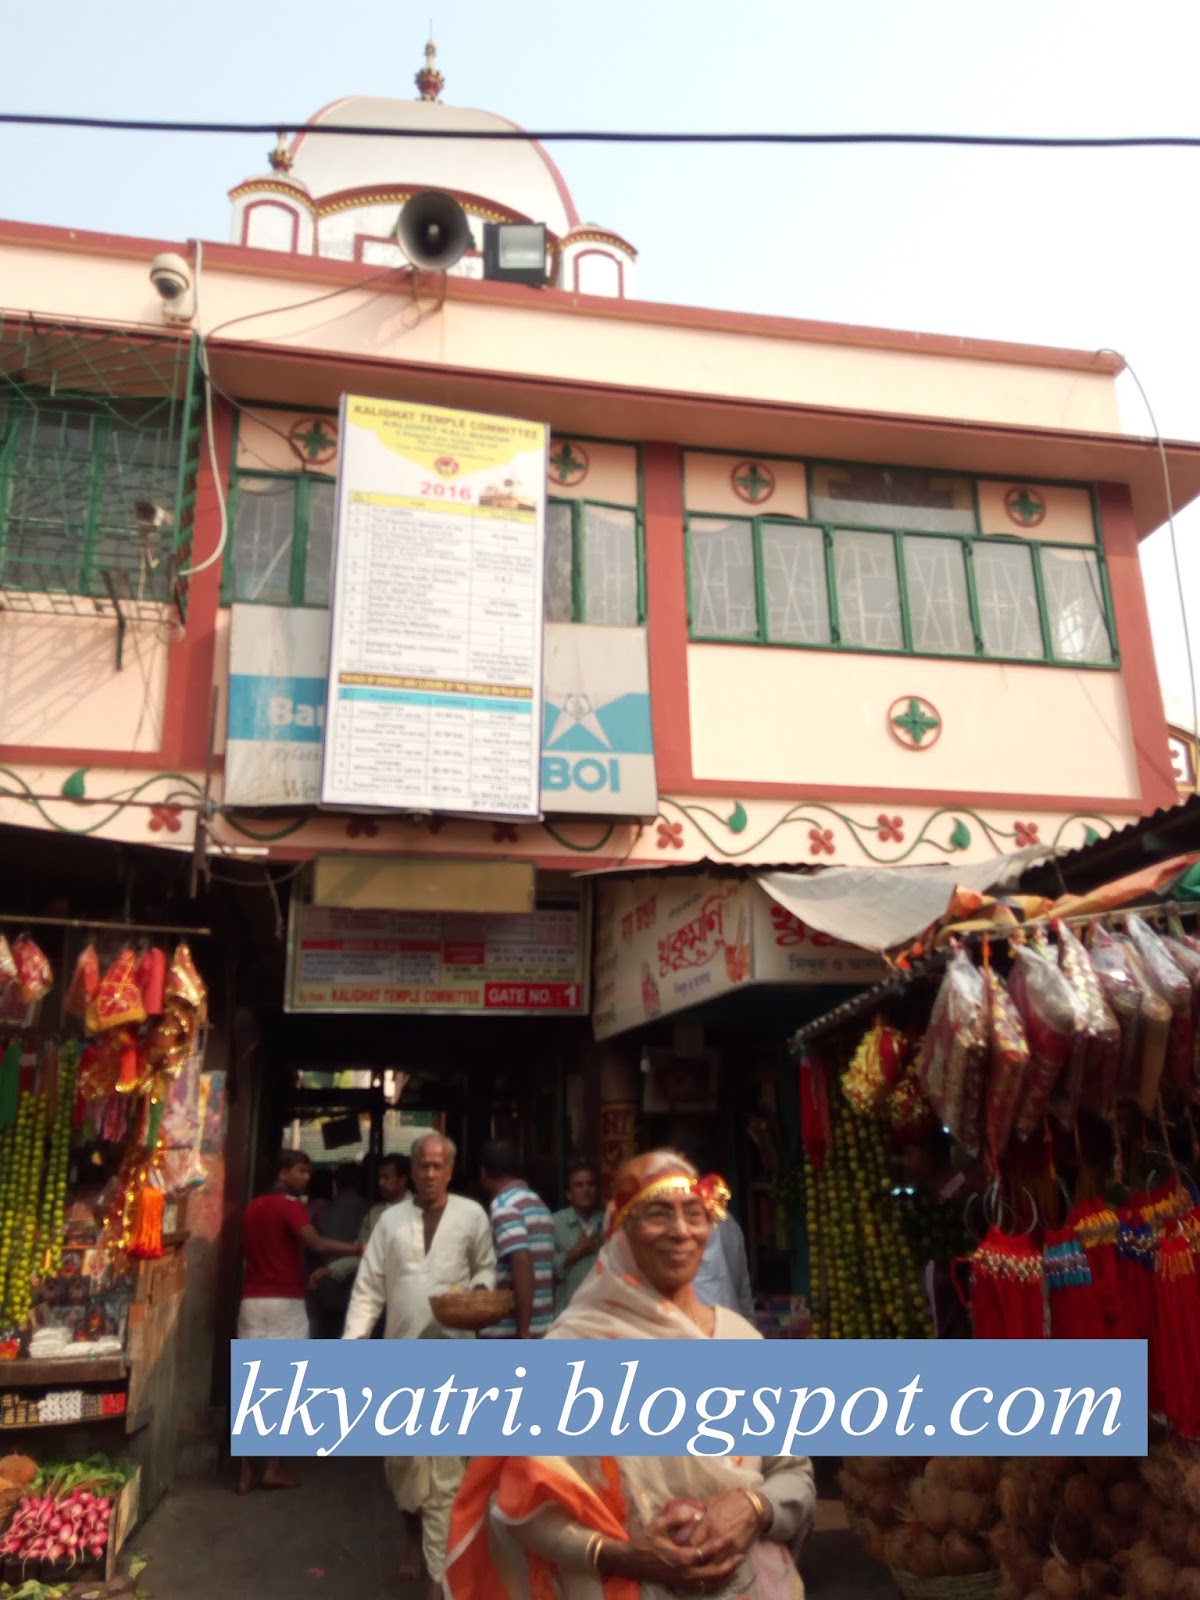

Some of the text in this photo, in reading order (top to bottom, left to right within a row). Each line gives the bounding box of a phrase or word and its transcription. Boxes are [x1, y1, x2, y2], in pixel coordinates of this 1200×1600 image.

[420, 413, 466, 428] TEMPLE
[469, 420, 539, 441] COMMITTEE
[420, 481, 472, 501] 2016
[541, 755, 621, 793] BOI
[488, 987, 526, 1004] GATE
[563, 984, 577, 1007] 1
